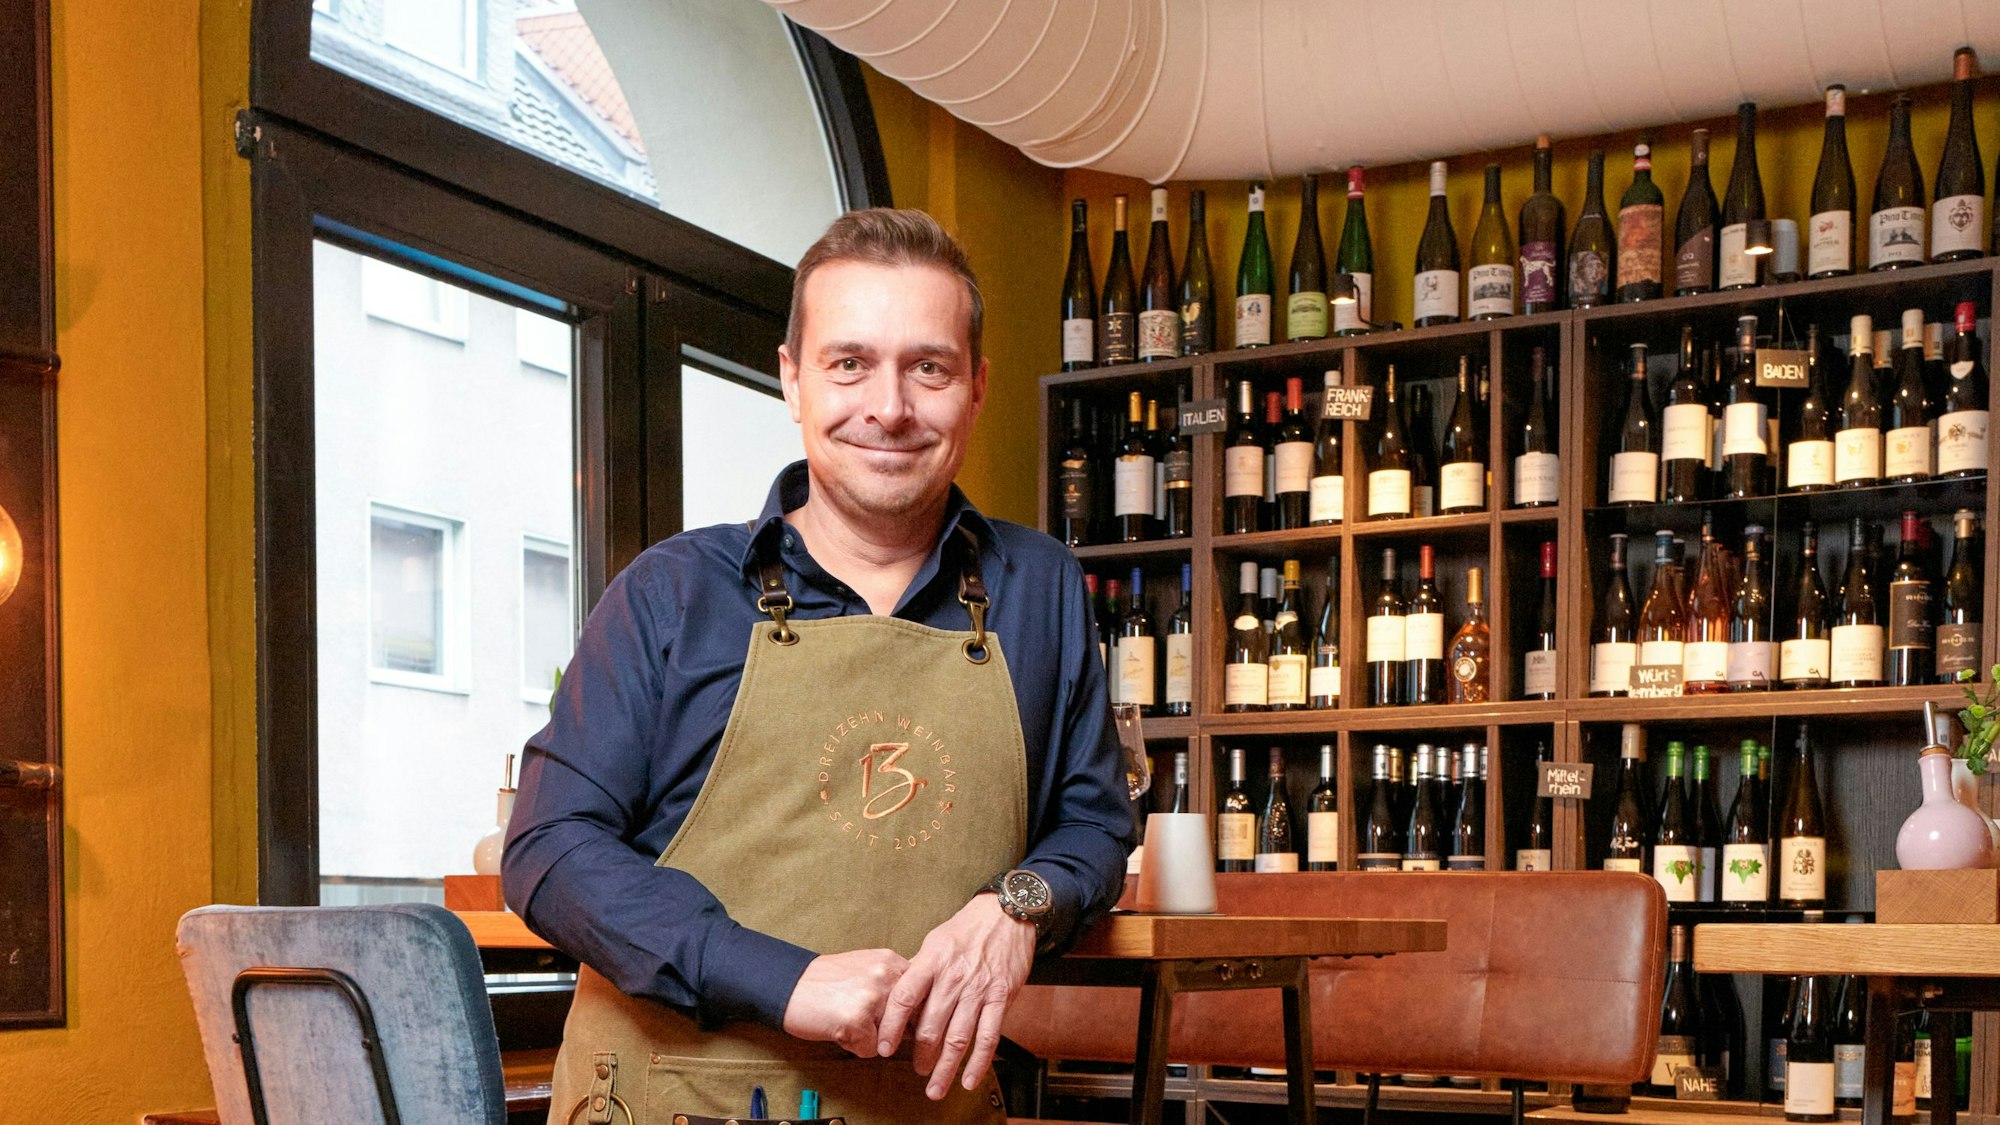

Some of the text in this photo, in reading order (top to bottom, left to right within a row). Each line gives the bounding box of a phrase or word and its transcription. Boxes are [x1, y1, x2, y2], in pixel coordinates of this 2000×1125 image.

[1763, 364, 1804, 379] BADEN
[1327, 388, 1371, 402] FRANK-
[1183, 408, 1226, 427] ITALIEN
[1325, 403, 1362, 417] REICH
[818, 710, 957, 793] DREIZEHN WEINBAR
[858, 742, 928, 820] 13
[1547, 768, 1586, 784] Mittel-
[1548, 783, 1581, 796] rhein
[829, 811, 942, 850] SEIT 2020
[1683, 1078, 1718, 1092] NAHE
